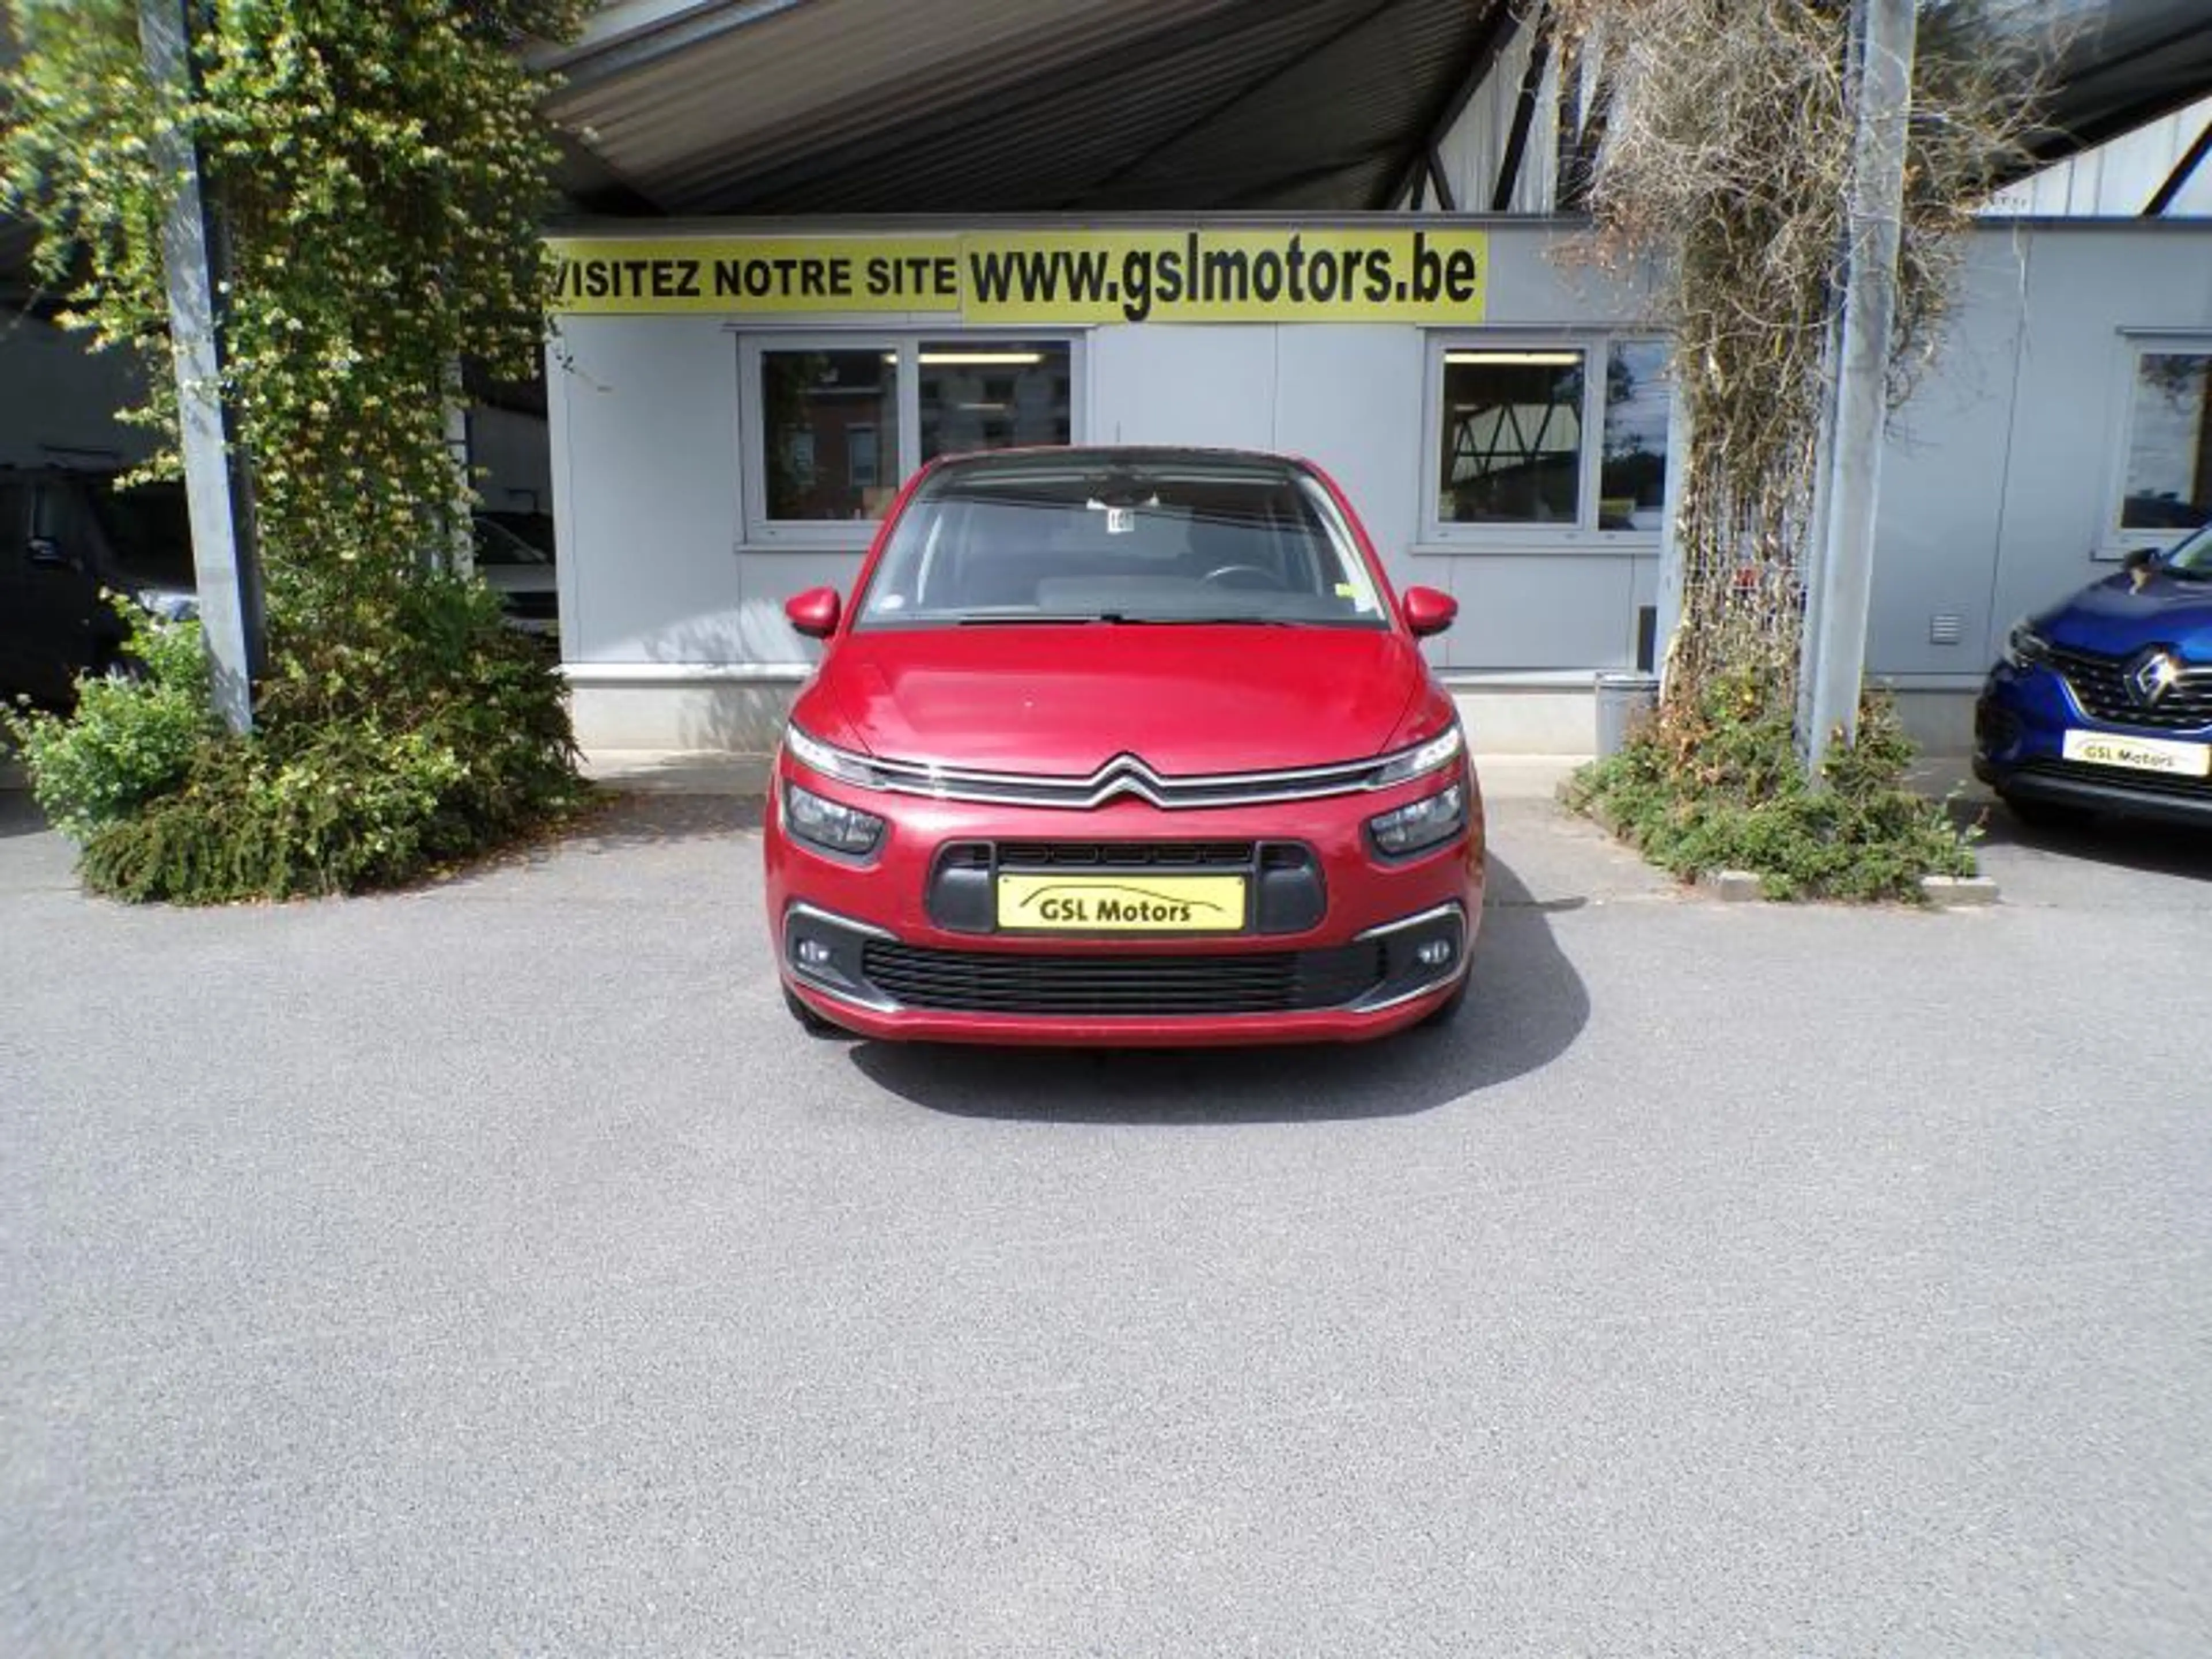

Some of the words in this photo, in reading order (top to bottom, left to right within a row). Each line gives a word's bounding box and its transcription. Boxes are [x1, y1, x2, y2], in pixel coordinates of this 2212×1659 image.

[715, 259, 851, 296] NOTRE
[867, 257, 957, 294] SITE
[970, 232, 1475, 321] www.gslmotors.be
[1040, 899, 1088, 921] GSL
[1097, 899, 1191, 921] Motors
